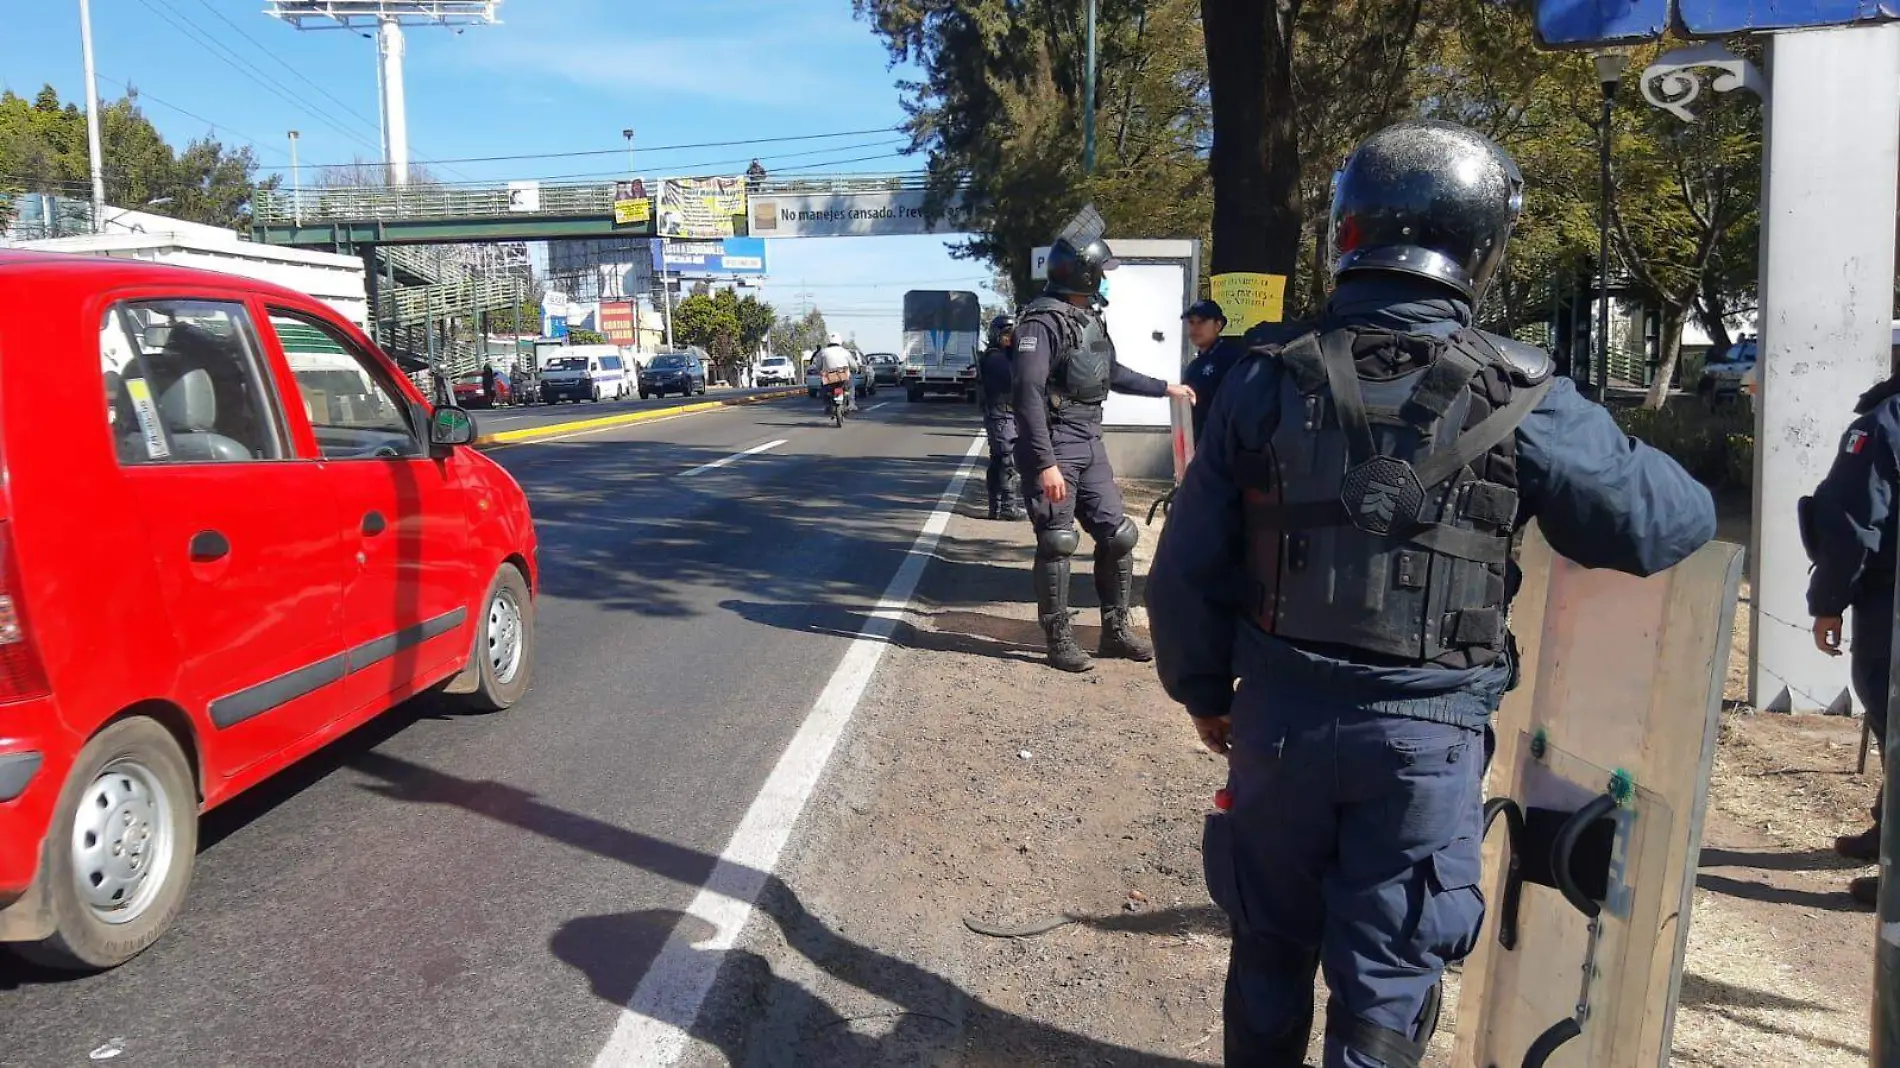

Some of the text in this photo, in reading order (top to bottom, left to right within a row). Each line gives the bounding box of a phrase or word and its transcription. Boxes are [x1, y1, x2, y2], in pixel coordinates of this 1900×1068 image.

[781, 208, 796, 220] No
[799, 206, 845, 222] manejes
[848, 205, 896, 220] cansado.
